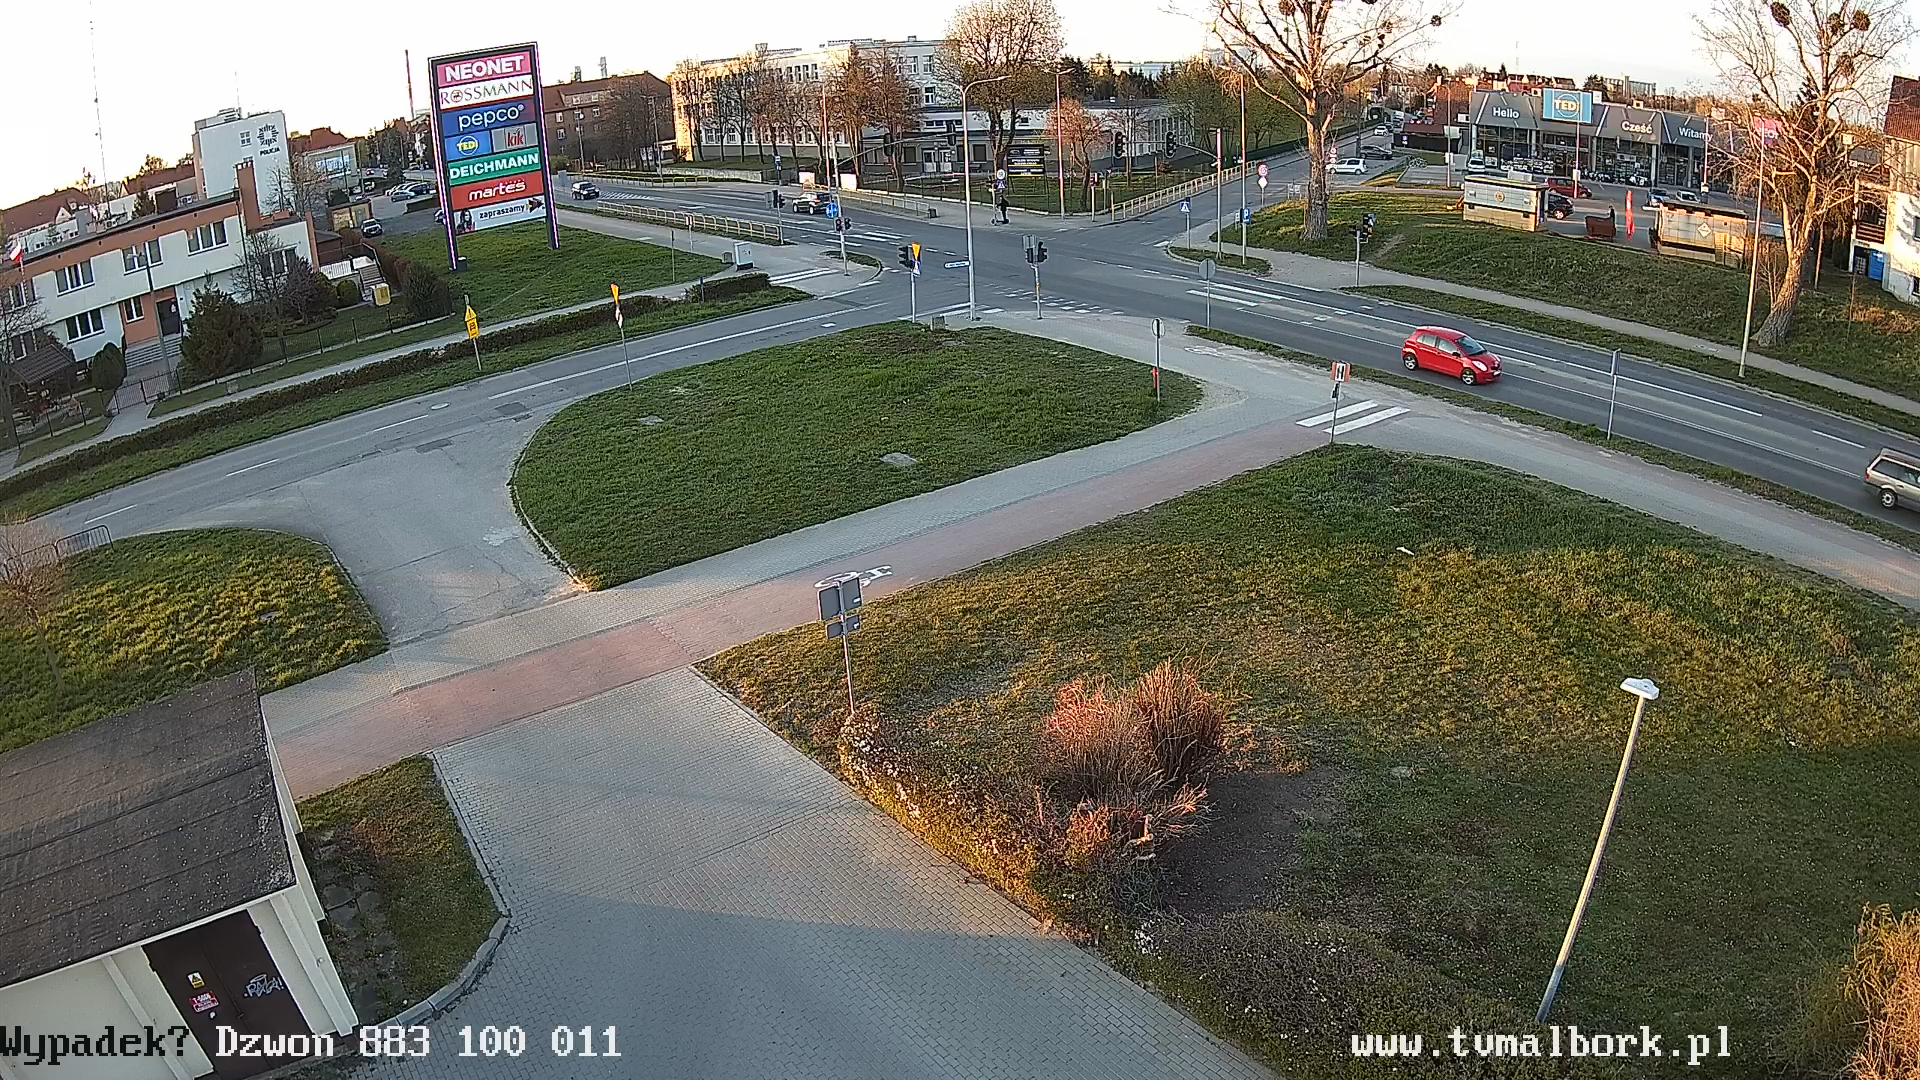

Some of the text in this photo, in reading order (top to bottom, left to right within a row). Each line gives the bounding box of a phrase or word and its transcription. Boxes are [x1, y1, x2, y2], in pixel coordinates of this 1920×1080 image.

[445, 55, 524, 82] NEONET
[440, 78, 533, 105] ROSSMANN
[1492, 106, 1520, 119] Hello
[1621, 120, 1653, 134] Cześć
[1679, 126, 1713, 142] Witamy
[259, 147, 281, 156] POLICJA
[450, 153, 539, 180] DEICHMANN
[468, 180, 526, 201] martes
[479, 204, 525, 219] zapraszamy
